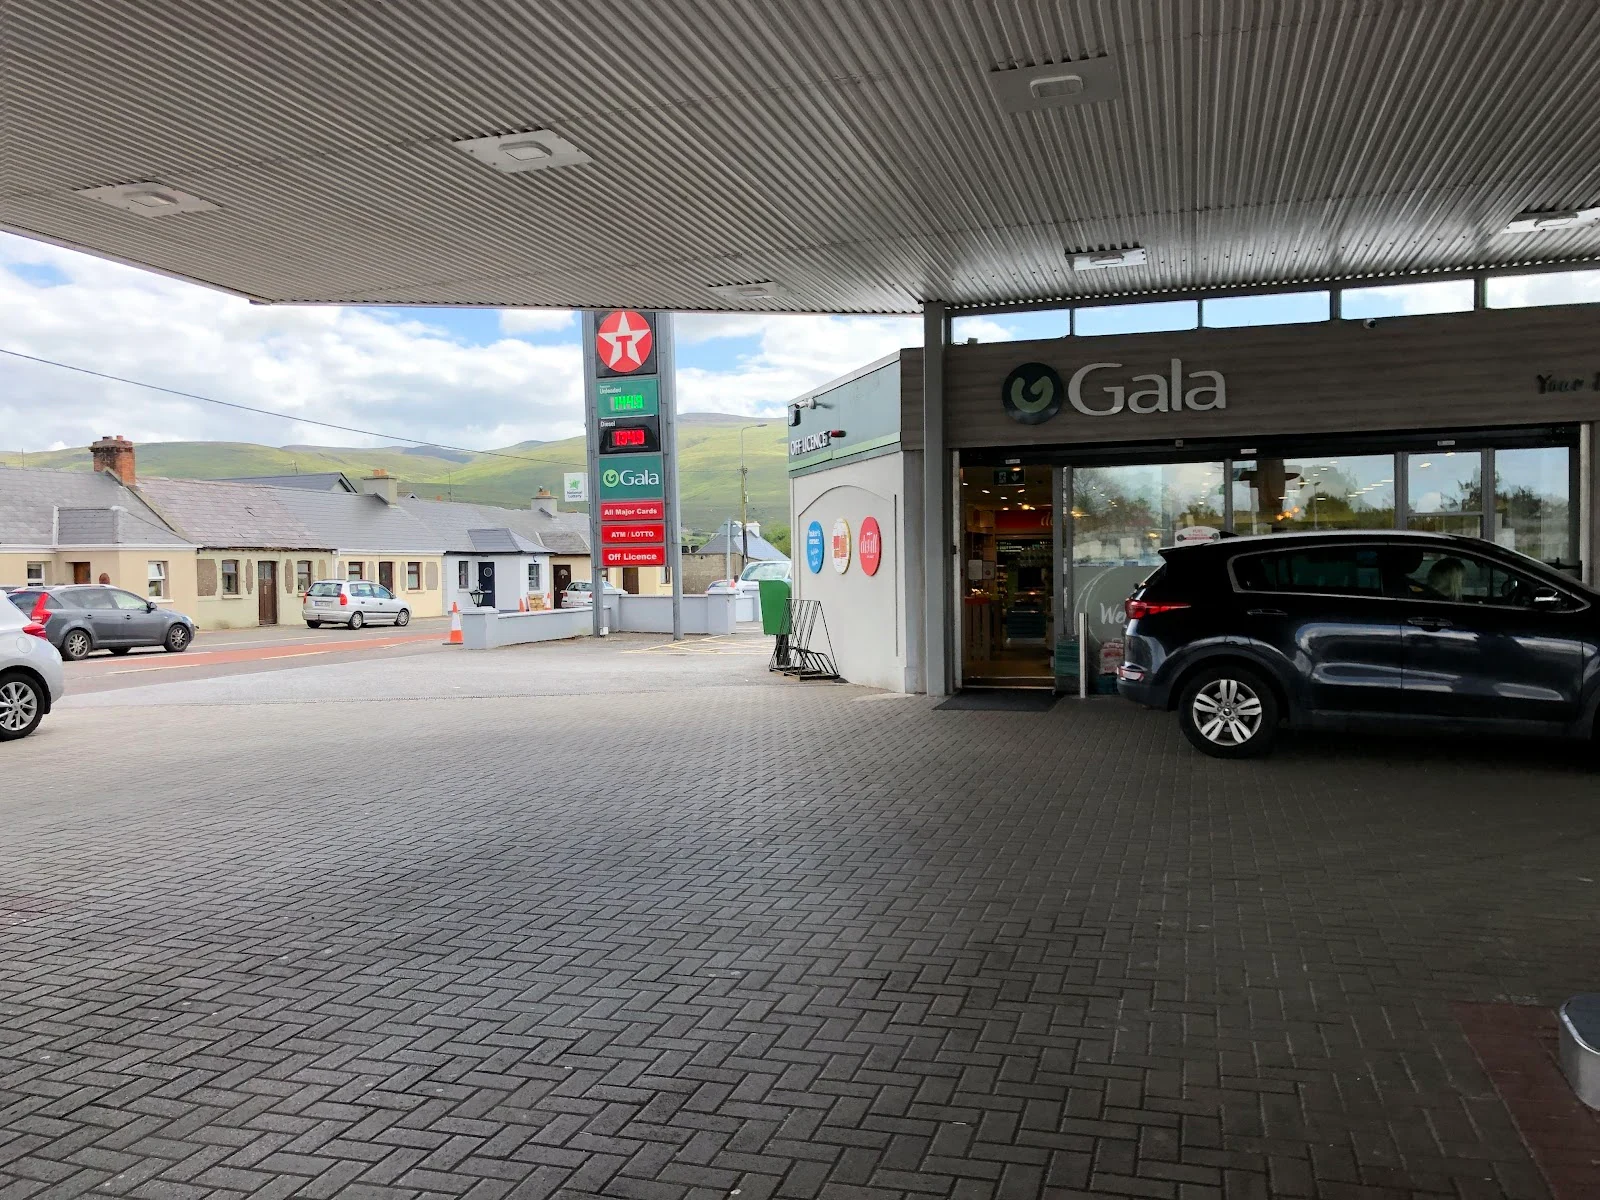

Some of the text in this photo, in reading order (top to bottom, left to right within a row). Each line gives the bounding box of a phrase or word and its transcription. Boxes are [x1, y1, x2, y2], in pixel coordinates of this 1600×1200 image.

[1068, 358, 1226, 416] Gala
[790, 431, 828, 455] OFF LICENCE
[620, 469, 660, 486] Gala
[604, 507, 657, 517] All Major Cards
[608, 552, 657, 561] Off Licence
